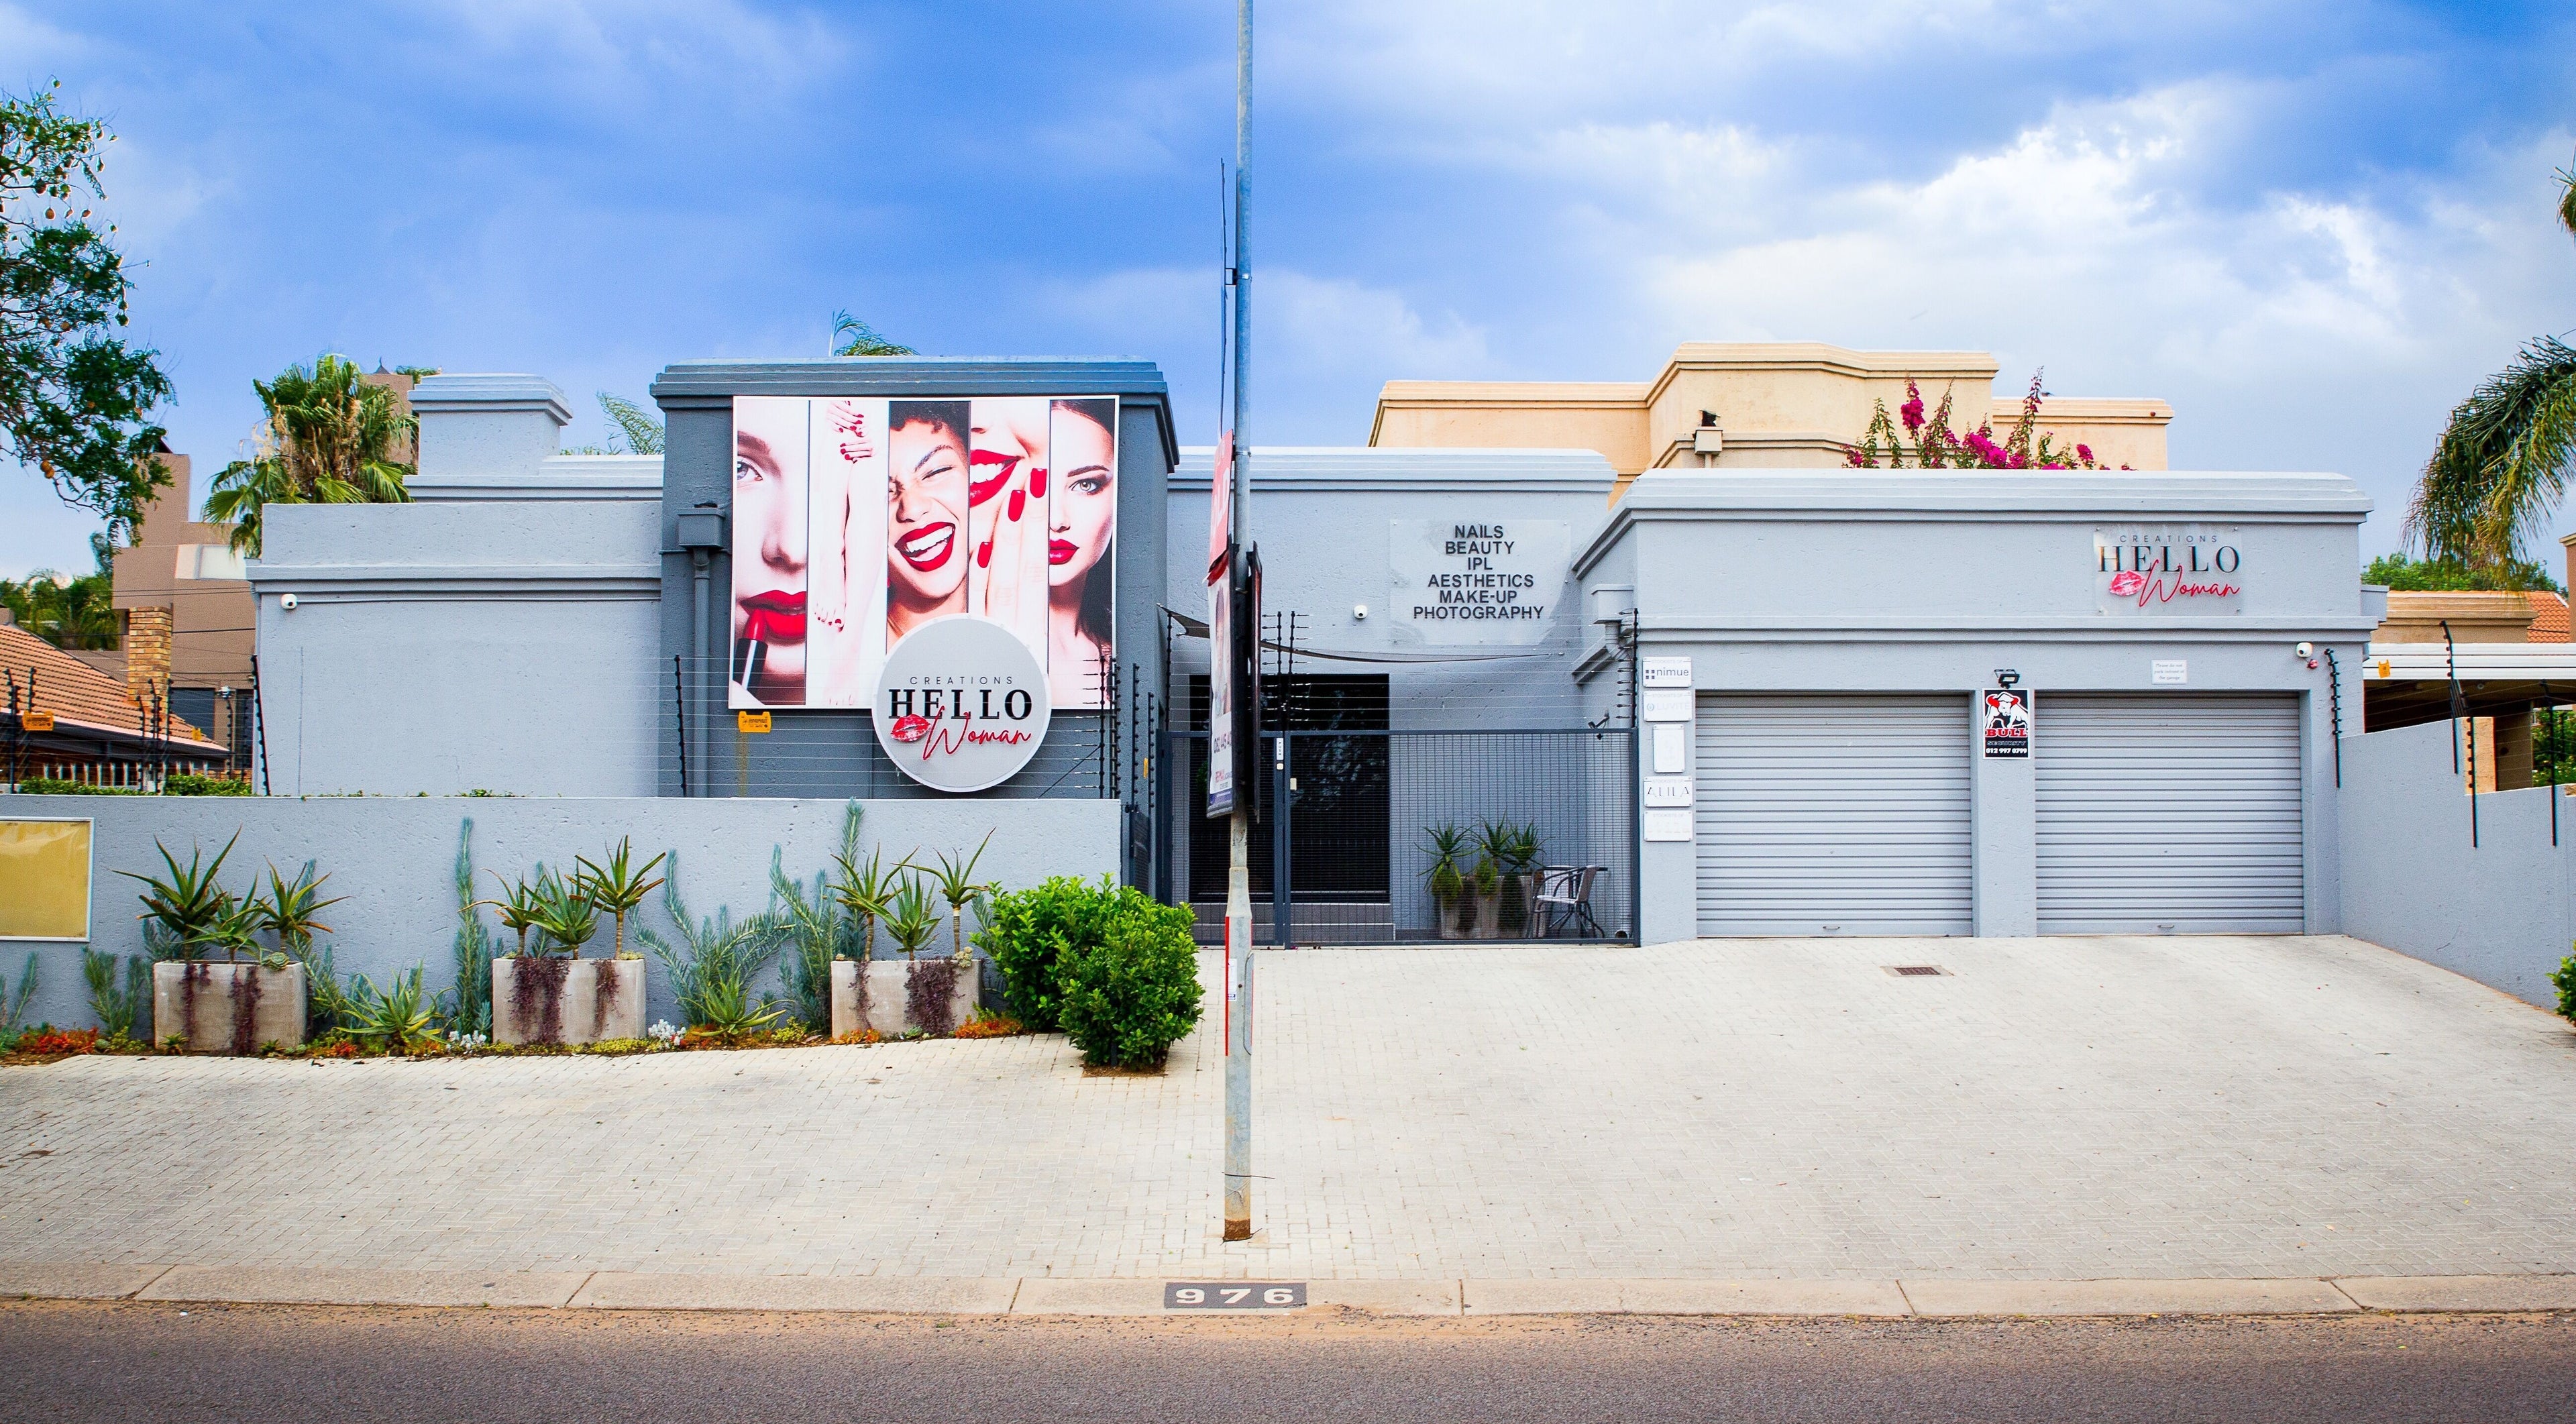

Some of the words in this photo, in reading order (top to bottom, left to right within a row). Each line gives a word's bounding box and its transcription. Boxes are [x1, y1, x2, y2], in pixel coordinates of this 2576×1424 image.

[1454, 525, 1503, 539] NAILS
[2119, 535, 2218, 543] CREATIONS
[1446, 541, 1515, 554] BEAUTY
[1468, 557, 1493, 570] IPL
[2098, 545, 2240, 573] HELLO
[1428, 574, 1534, 588] AESTHETICS
[2139, 559, 2241, 607] Woman
[1440, 590, 1517, 604] MAKE-UP
[1413, 606, 1544, 620] PHOTOGRAPHY
[1656, 667, 1689, 676] nimue
[910, 676, 1013, 685] CREATIONS
[888, 689, 1032, 720] HELLO
[923, 705, 1032, 761] Woman
[1986, 728, 2027, 737] BULL
[1175, 1288, 1294, 1304] 976
